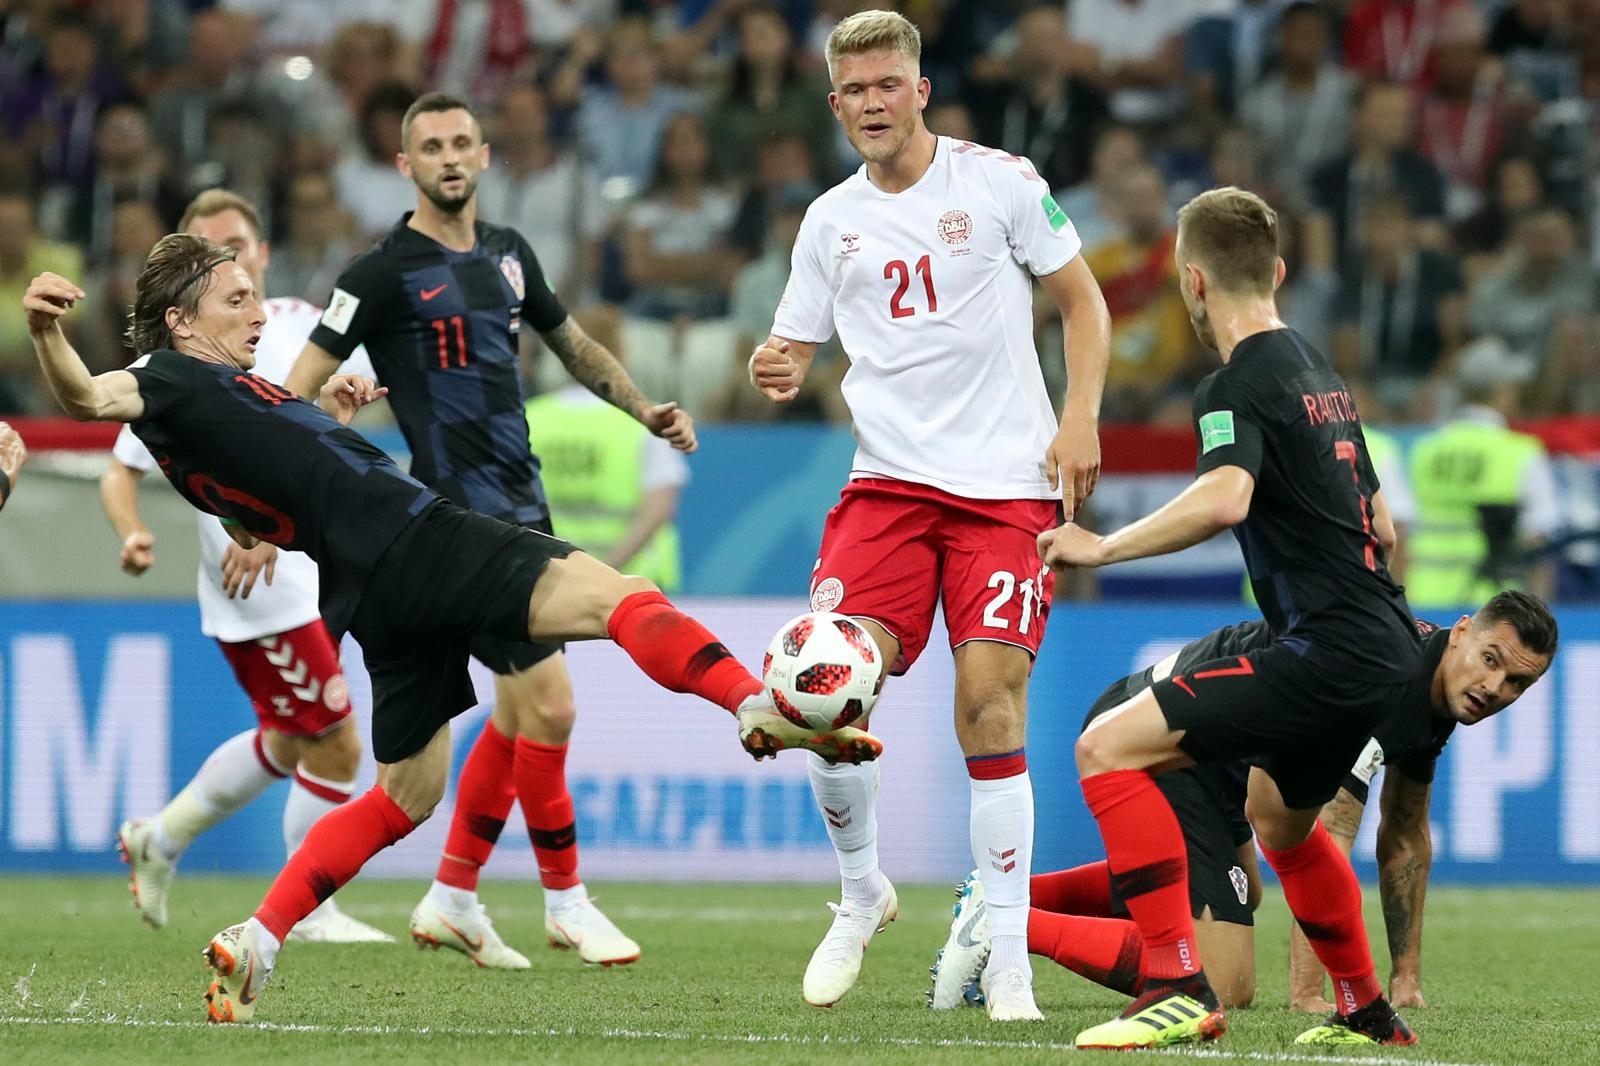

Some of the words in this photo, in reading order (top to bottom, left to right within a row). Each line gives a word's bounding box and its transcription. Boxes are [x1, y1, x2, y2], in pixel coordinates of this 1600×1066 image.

[884, 254, 938, 319] 21
[431, 315, 468, 369] 11
[982, 570, 1034, 635] 21
[1193, 655, 1255, 680] 7
